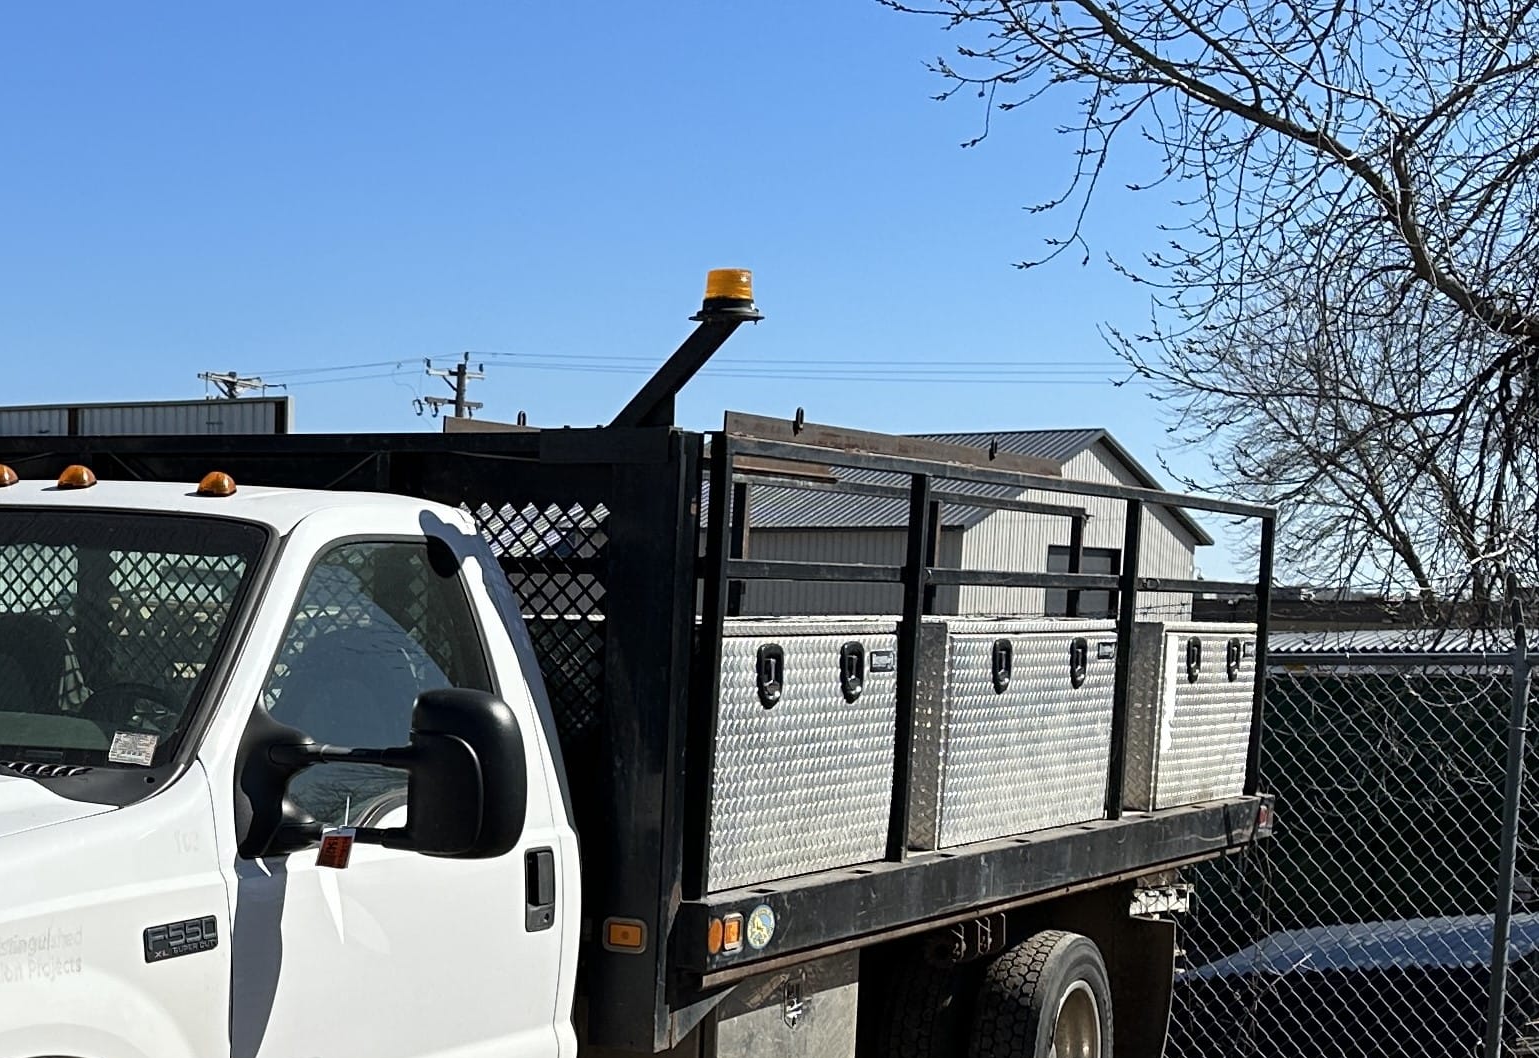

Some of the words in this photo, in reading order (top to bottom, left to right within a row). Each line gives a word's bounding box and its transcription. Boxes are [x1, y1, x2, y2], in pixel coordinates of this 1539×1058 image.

[148, 917, 217, 951] F550
[154, 949, 170, 959] XL
[28, 956, 83, 982] Projects
